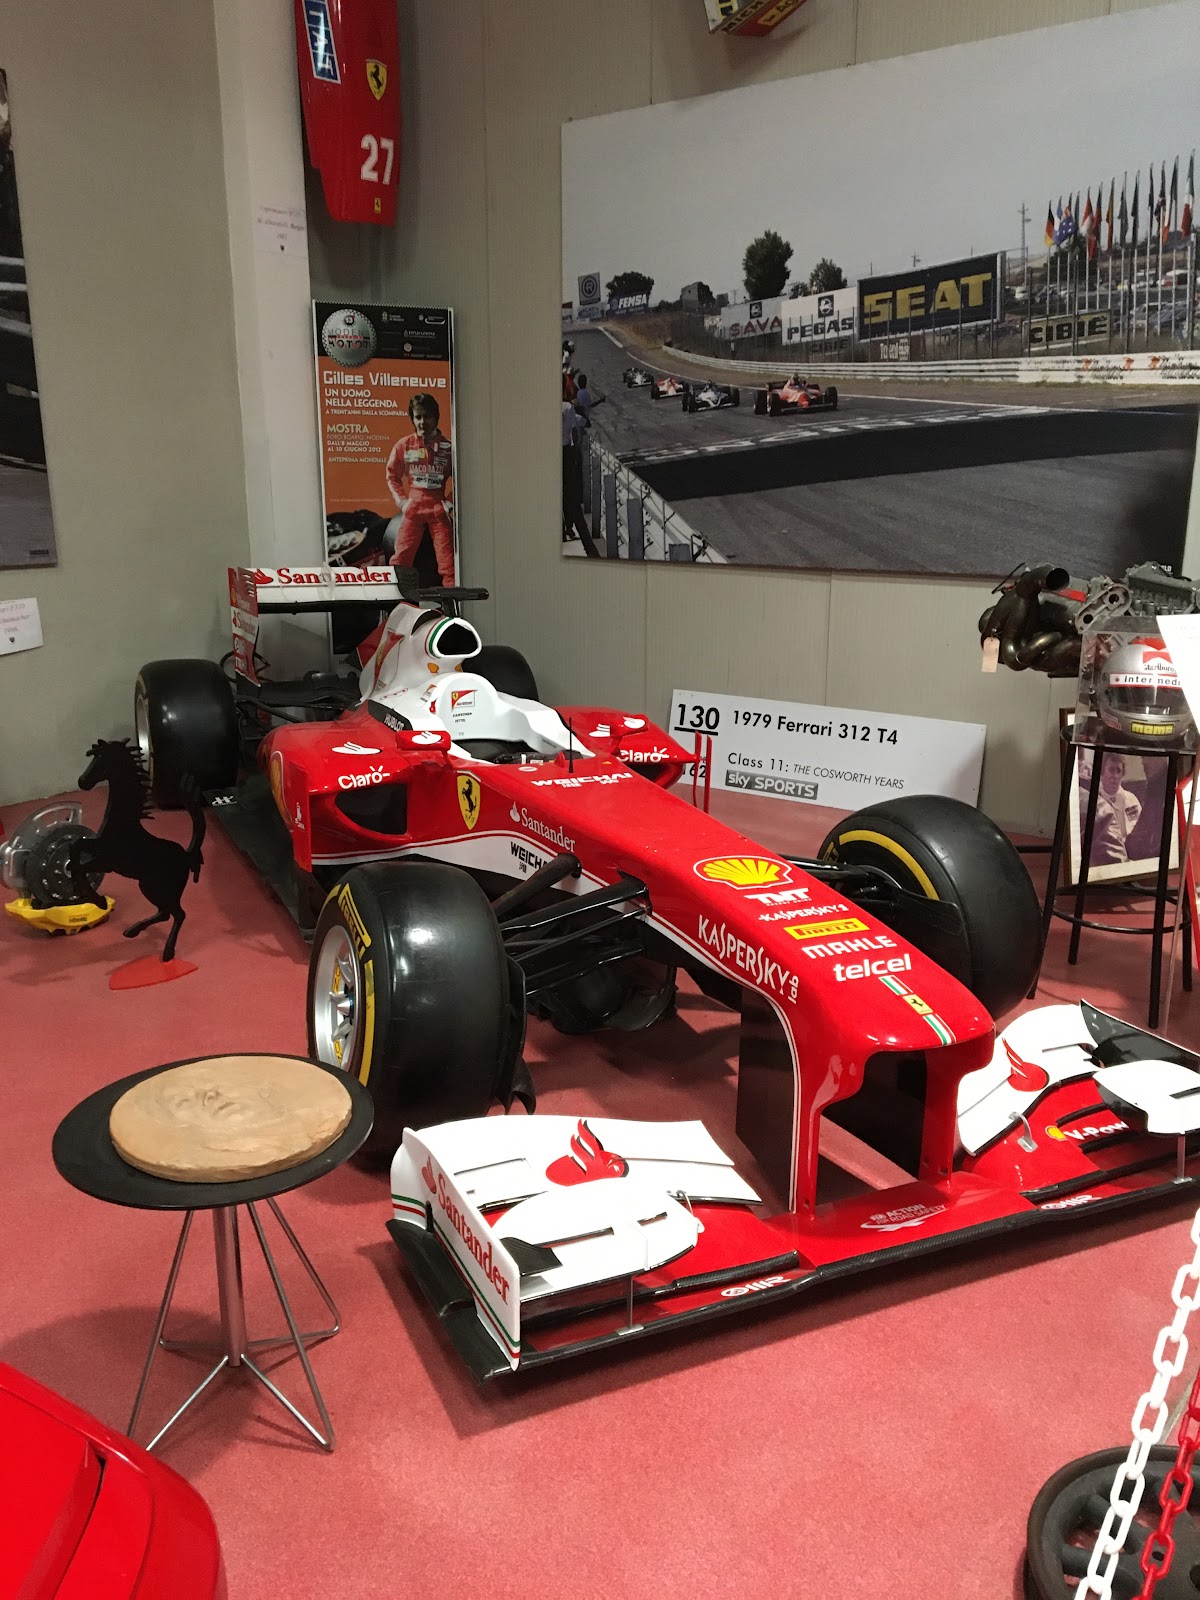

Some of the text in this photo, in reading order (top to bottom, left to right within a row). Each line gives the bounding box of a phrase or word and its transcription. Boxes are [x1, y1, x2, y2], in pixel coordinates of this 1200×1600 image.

[360, 133, 395, 186] 27
[618, 293, 648, 309] FEMSA
[864, 272, 993, 325] SEAT
[730, 315, 782, 337] SAVA
[323, 371, 364, 385] Gilles
[369, 372, 447, 388] Villeneuve
[325, 388, 371, 398] UN UOMO
[325, 398, 398, 408] NELLA LEGGENDA
[326, 423, 370, 434] MOSTRA
[383, 712, 405, 732] HUBLOT
[677, 703, 720, 731] 130
[733, 709, 898, 745] 1979 Ferrari 312 T4
[616, 747, 669, 763] Claro
[337, 768, 390, 790] Claro
[531, 772, 633, 788] WEICHAI
[727, 752, 905, 790] Class 11: THE COSWORTH YEARS
[728, 771, 816, 798] sky SPORTS
[521, 807, 576, 854] Santander
[743, 887, 810, 905] TNT
[792, 920, 862, 936] PIRELLI
[698, 913, 791, 996] KASPERSKY
[801, 935, 898, 960] MAHLE
[832, 953, 912, 982] telcel
[787, 974, 800, 1005] lab
[886, 1203, 926, 1217] ACTION
[888, 1213, 914, 1222] ROAD
[914, 1204, 946, 1216] SAFETY
[437, 1172, 511, 1306] Santander
